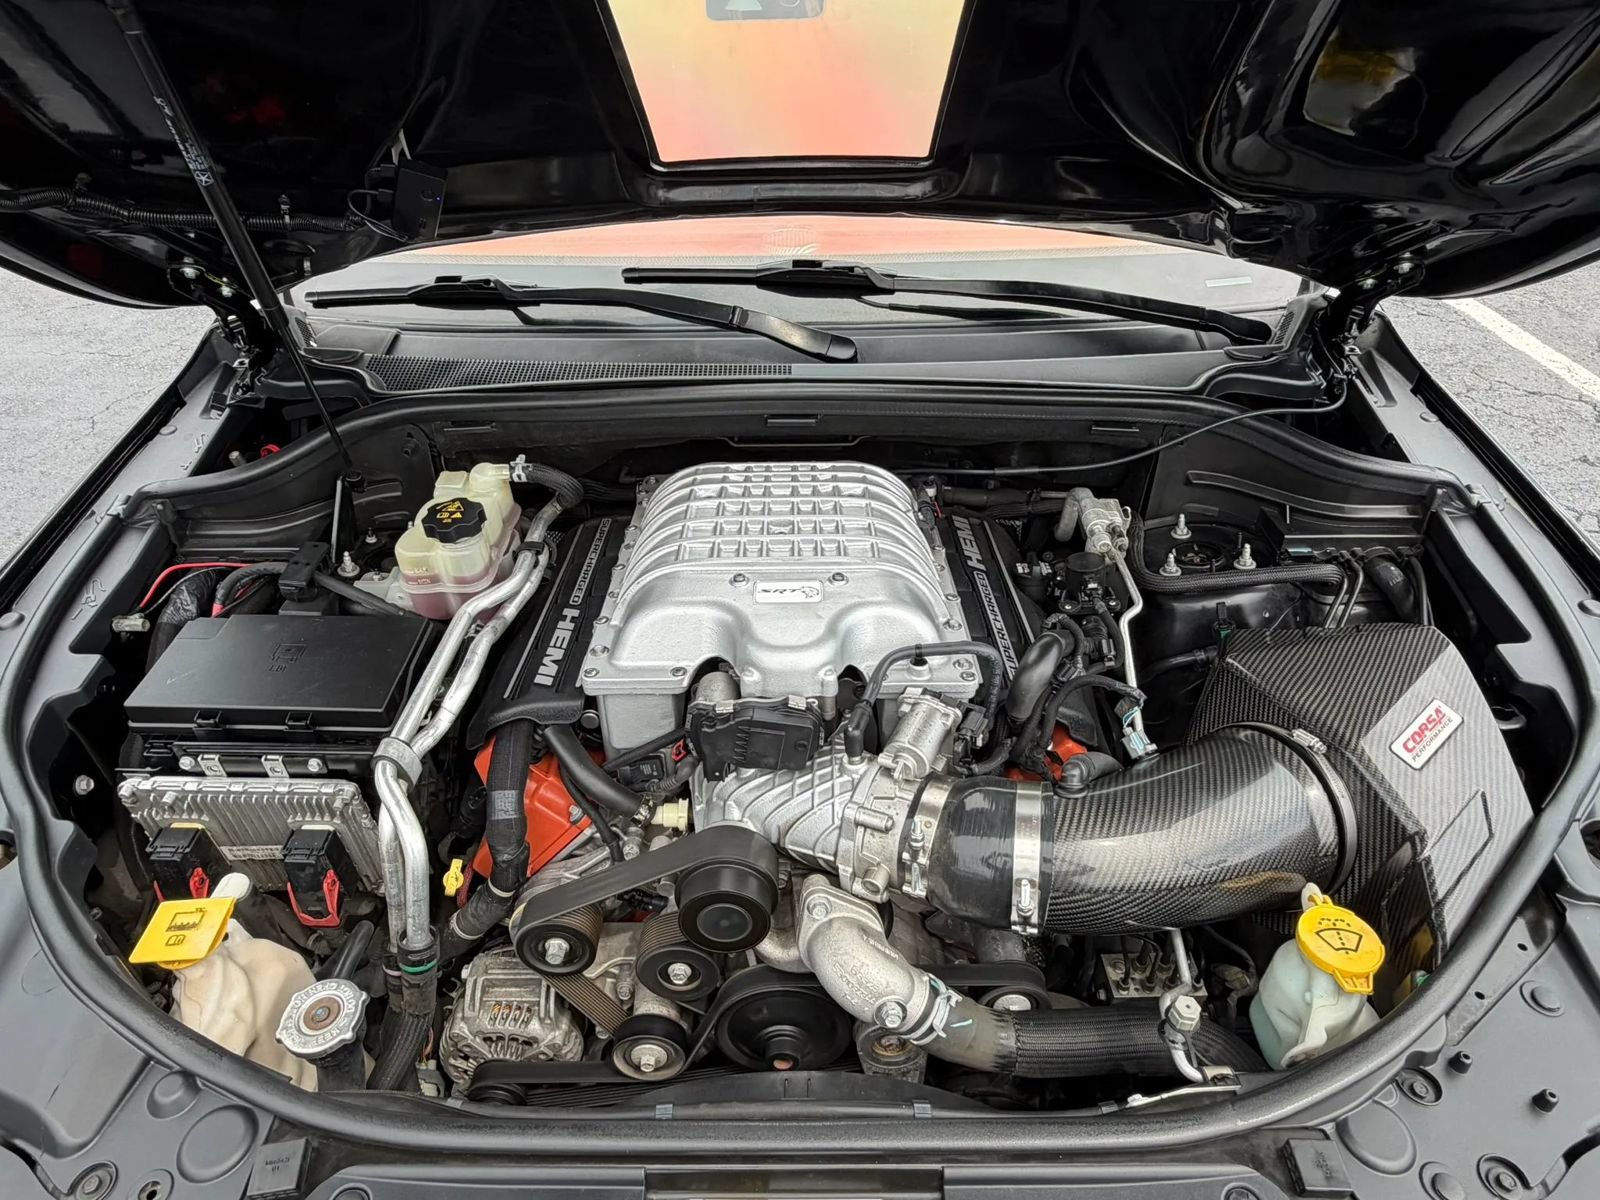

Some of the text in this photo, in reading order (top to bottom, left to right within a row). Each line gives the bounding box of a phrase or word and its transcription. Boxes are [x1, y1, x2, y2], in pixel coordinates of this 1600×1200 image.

[952, 515, 987, 572] HEMI
[533, 519, 611, 686] SUPERCHARGED HEMI
[1402, 707, 1446, 753] CORSA
[1412, 718, 1454, 762] PERFORMANCE
